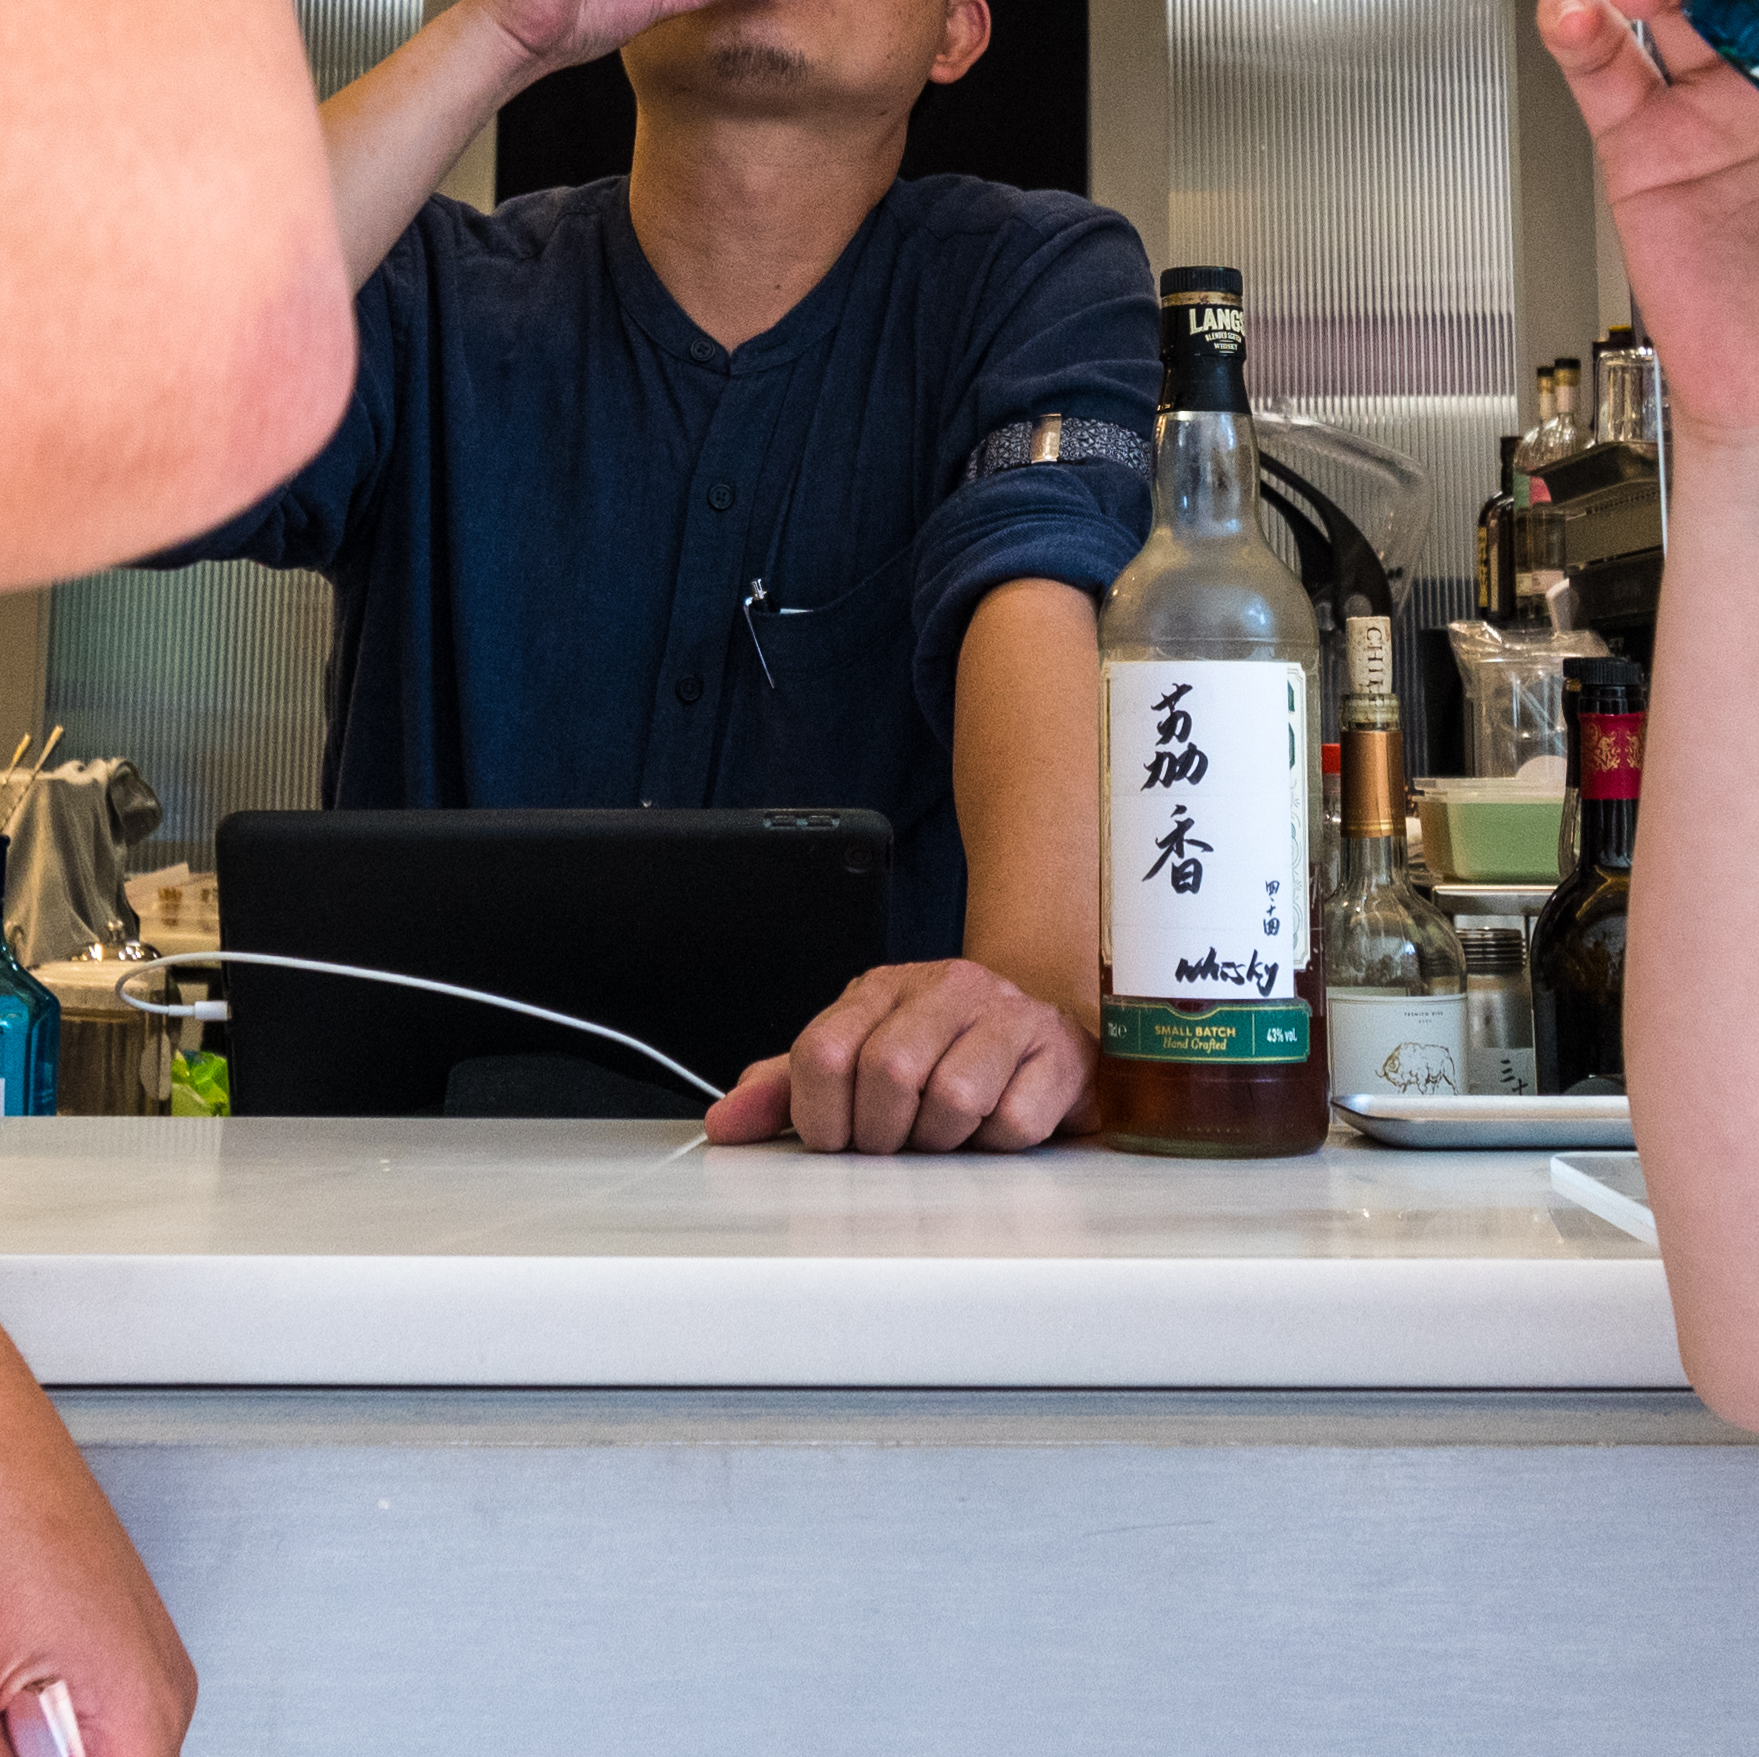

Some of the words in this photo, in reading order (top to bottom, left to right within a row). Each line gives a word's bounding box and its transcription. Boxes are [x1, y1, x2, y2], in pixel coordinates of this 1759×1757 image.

[1141, 683, 1214, 895] 荔香
[1154, 1025, 1192, 1037] SMALL
[1195, 1026, 1236, 1038] BATCH
[1163, 1037, 1188, 1050] Hand
[1191, 1038, 1227, 1054] Crafted
